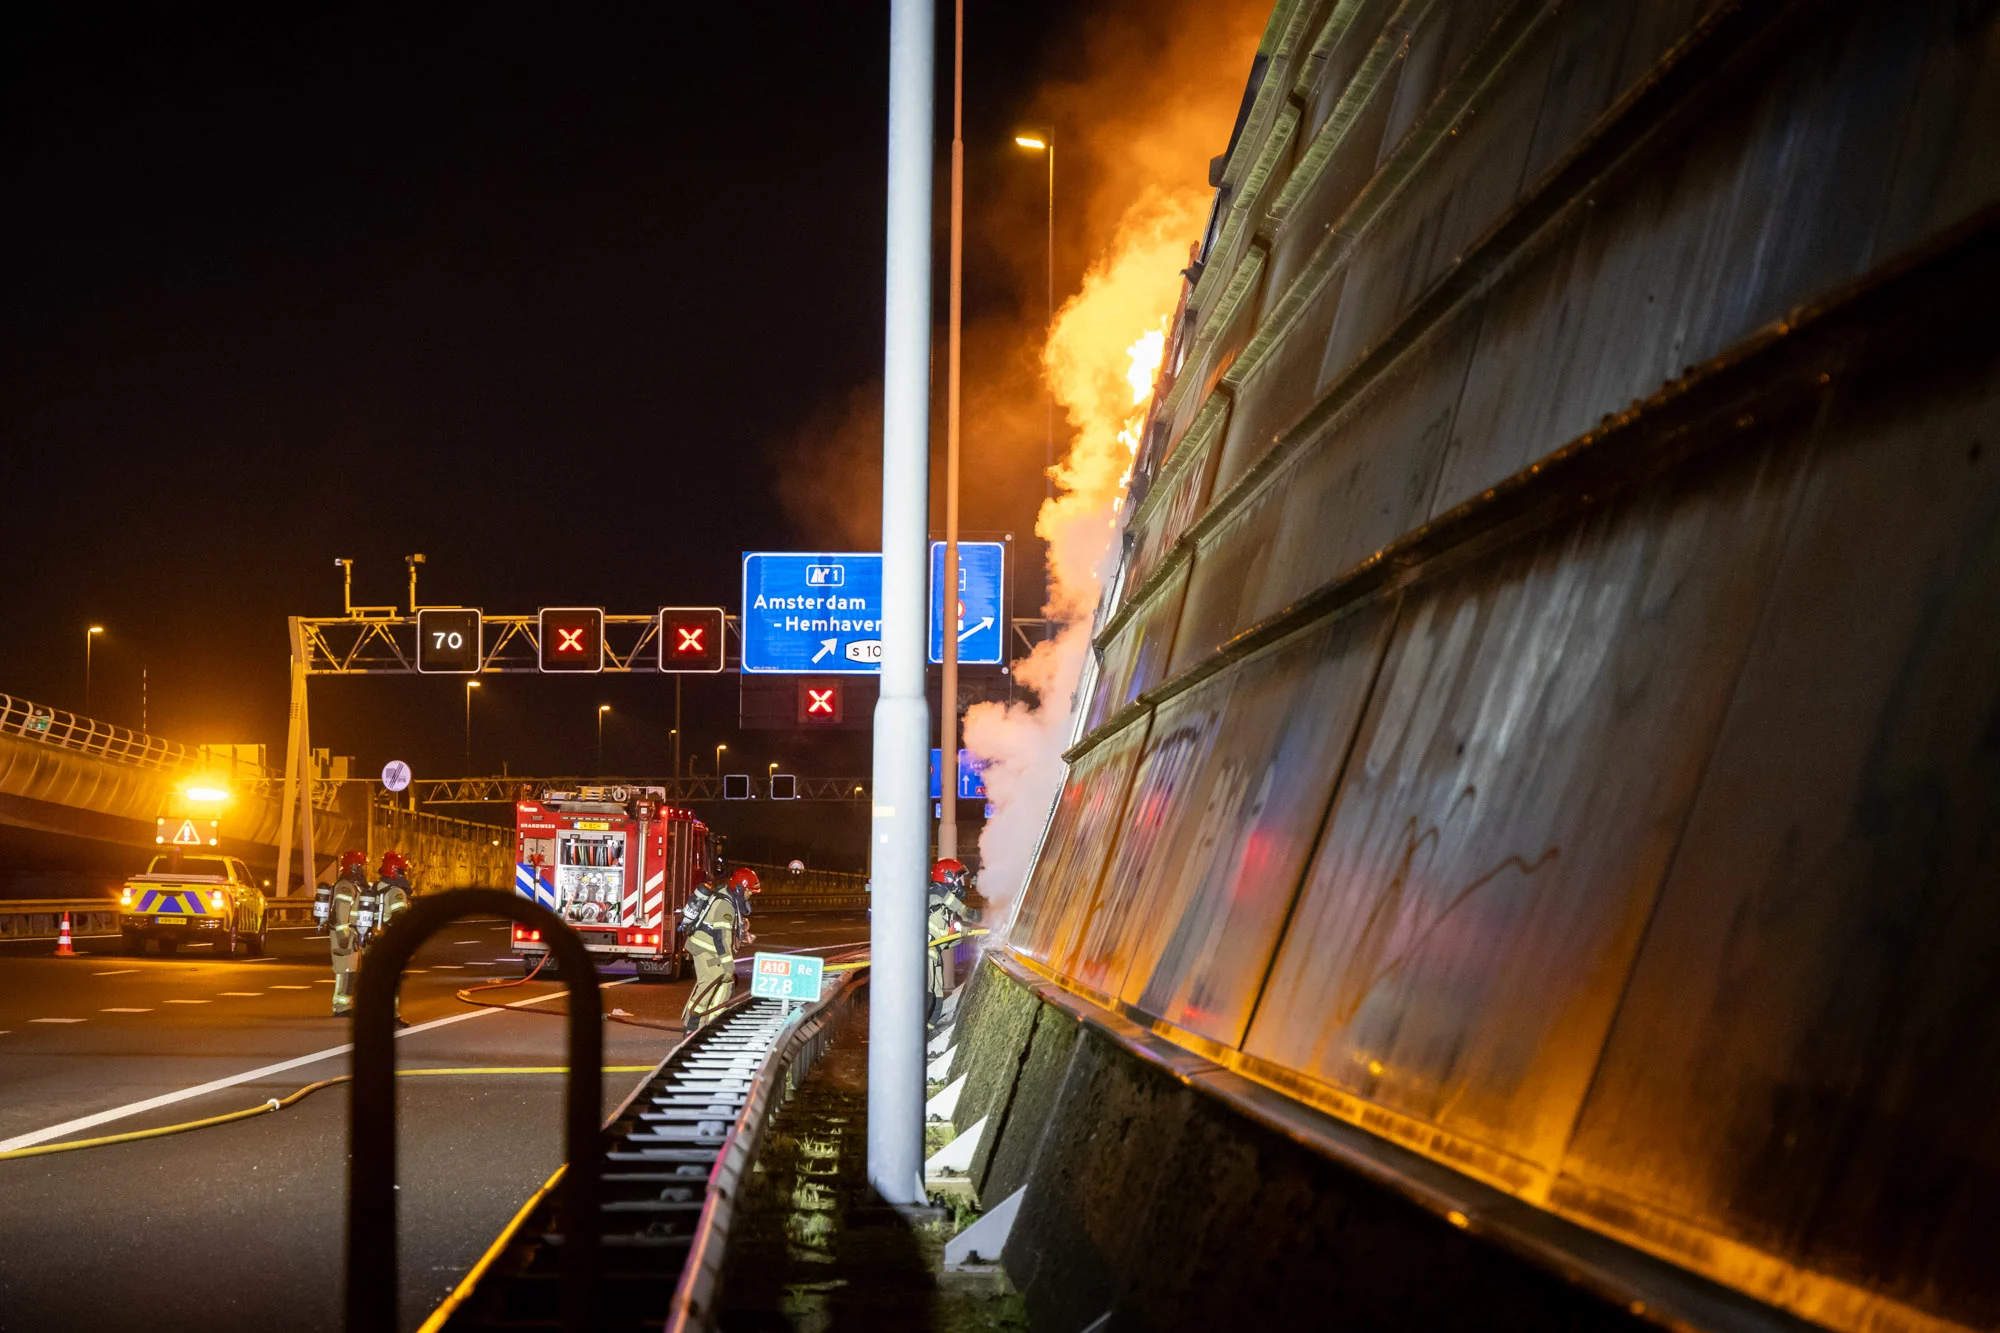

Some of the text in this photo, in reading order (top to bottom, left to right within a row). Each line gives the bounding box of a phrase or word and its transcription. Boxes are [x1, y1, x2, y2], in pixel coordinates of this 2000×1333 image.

[833, 569, 839, 582] 1
[753, 594, 866, 610] Amsterdam
[432, 632, 463, 649] 70
[867, 645, 882, 658] 10
[764, 962, 813, 976] A10 Re
